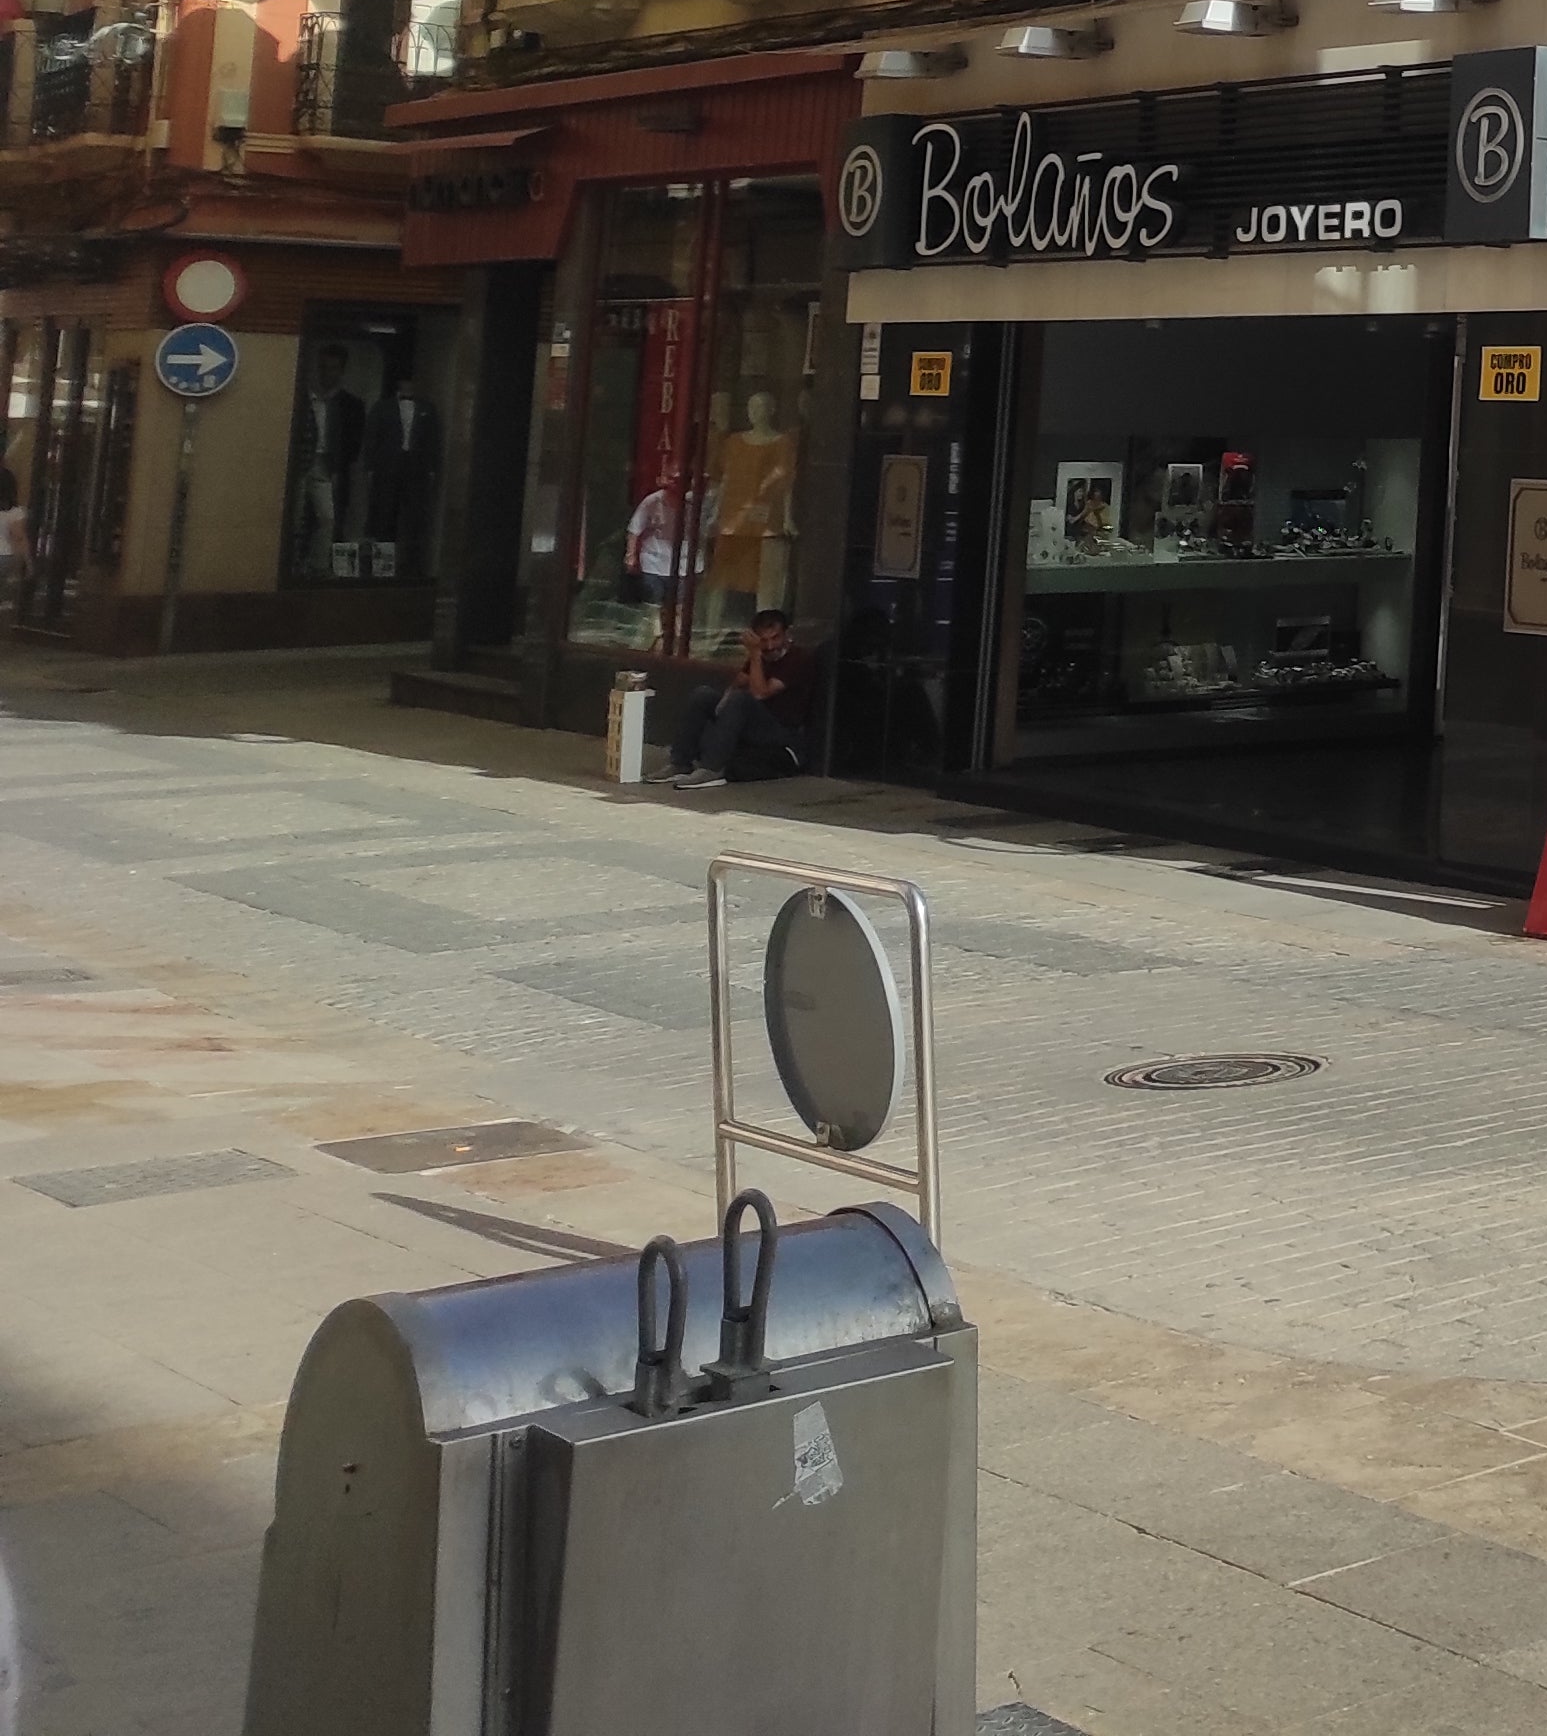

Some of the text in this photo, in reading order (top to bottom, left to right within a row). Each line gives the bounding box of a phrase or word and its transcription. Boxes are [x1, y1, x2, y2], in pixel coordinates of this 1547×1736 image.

[911, 111, 1179, 257] Bolaños
[1235, 199, 1403, 243] JOYERO
[1490, 352, 1532, 370] COMPRO
[1493, 371, 1527, 395] ORO
